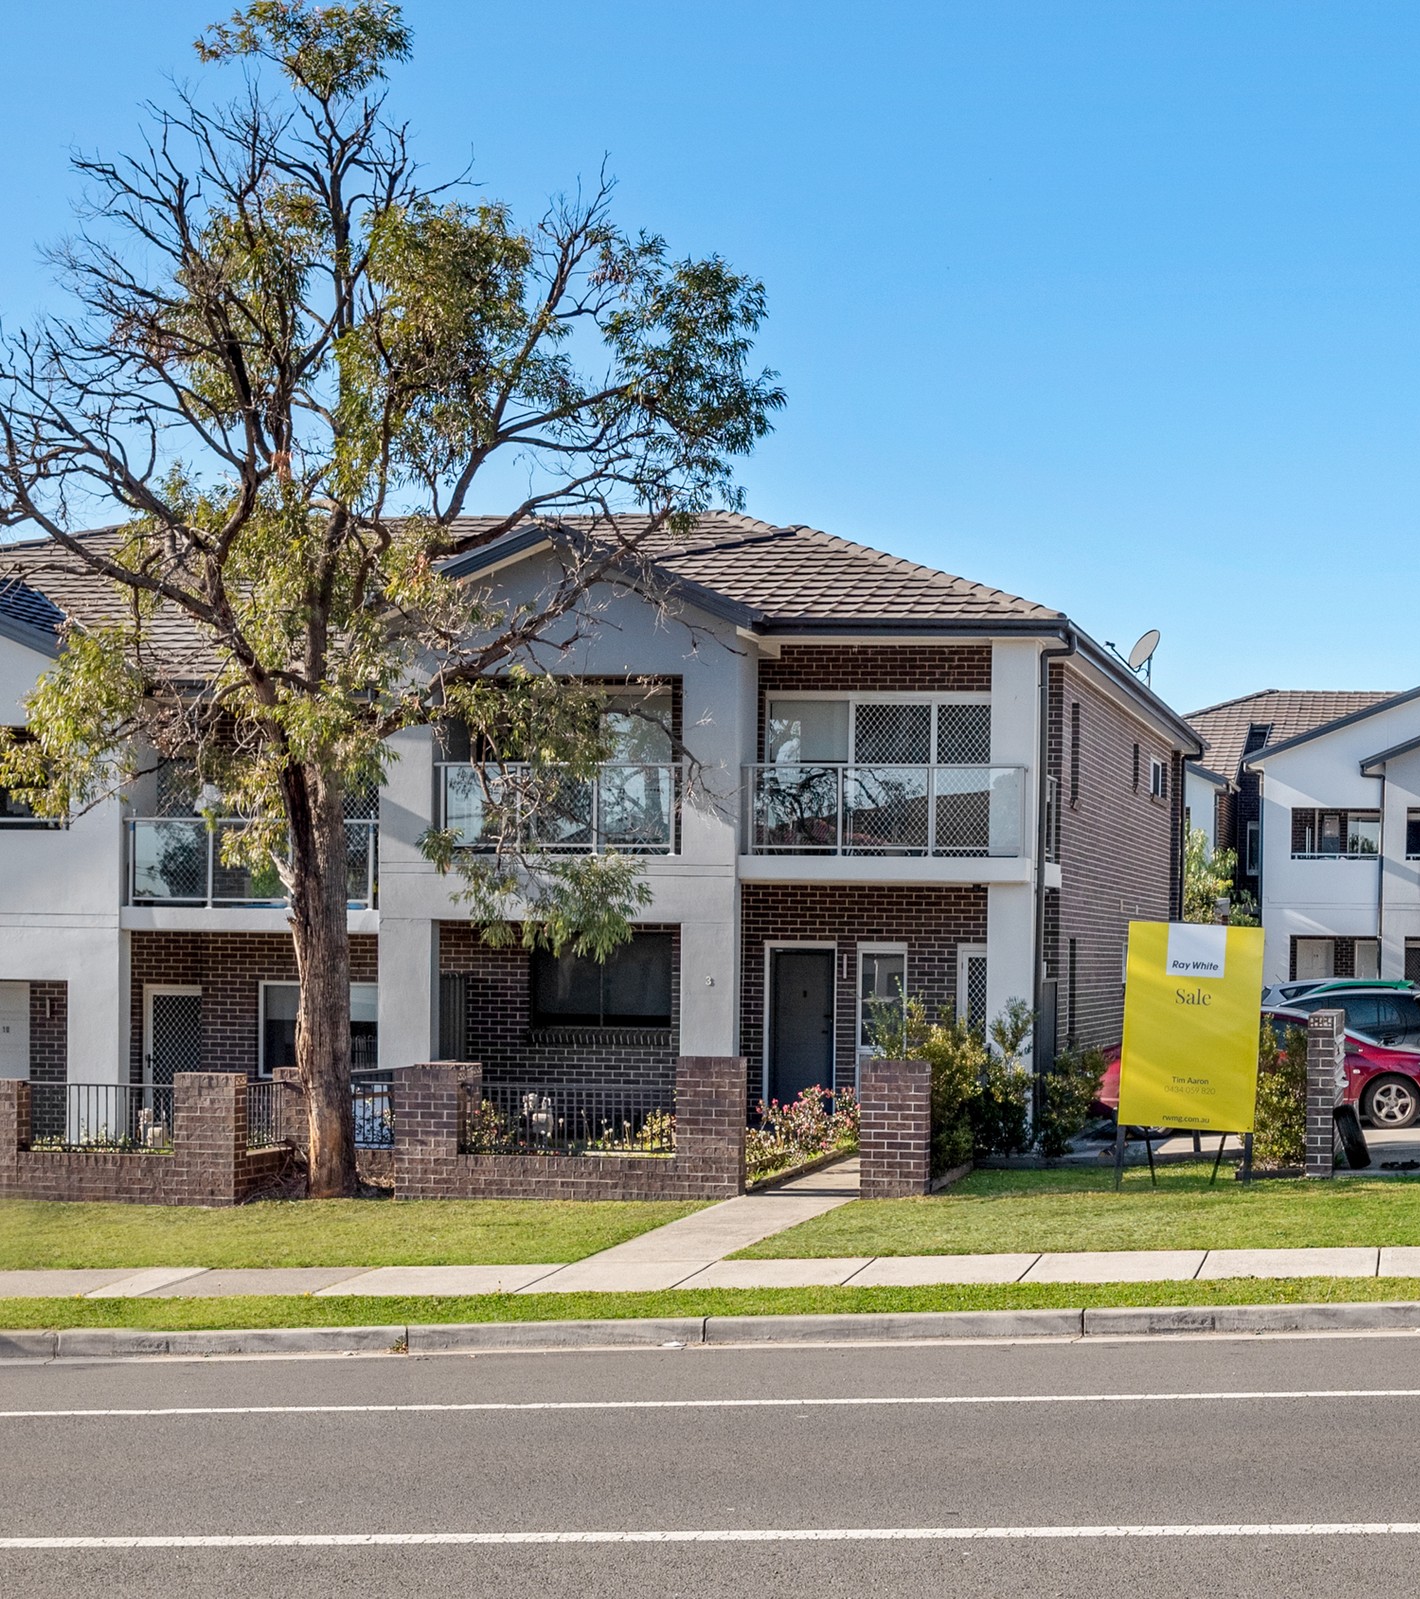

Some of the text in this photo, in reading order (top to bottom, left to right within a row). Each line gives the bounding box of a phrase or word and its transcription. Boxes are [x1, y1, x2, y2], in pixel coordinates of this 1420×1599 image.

[1172, 960, 1219, 971] Ray White
[705, 975, 712, 986] 3
[1175, 988, 1212, 1006] Sale
[1172, 1076, 1209, 1085] Tim Aaron
[1164, 1085, 1216, 1095] 0434 059 820
[1162, 1115, 1210, 1124] rwmg.com.au
